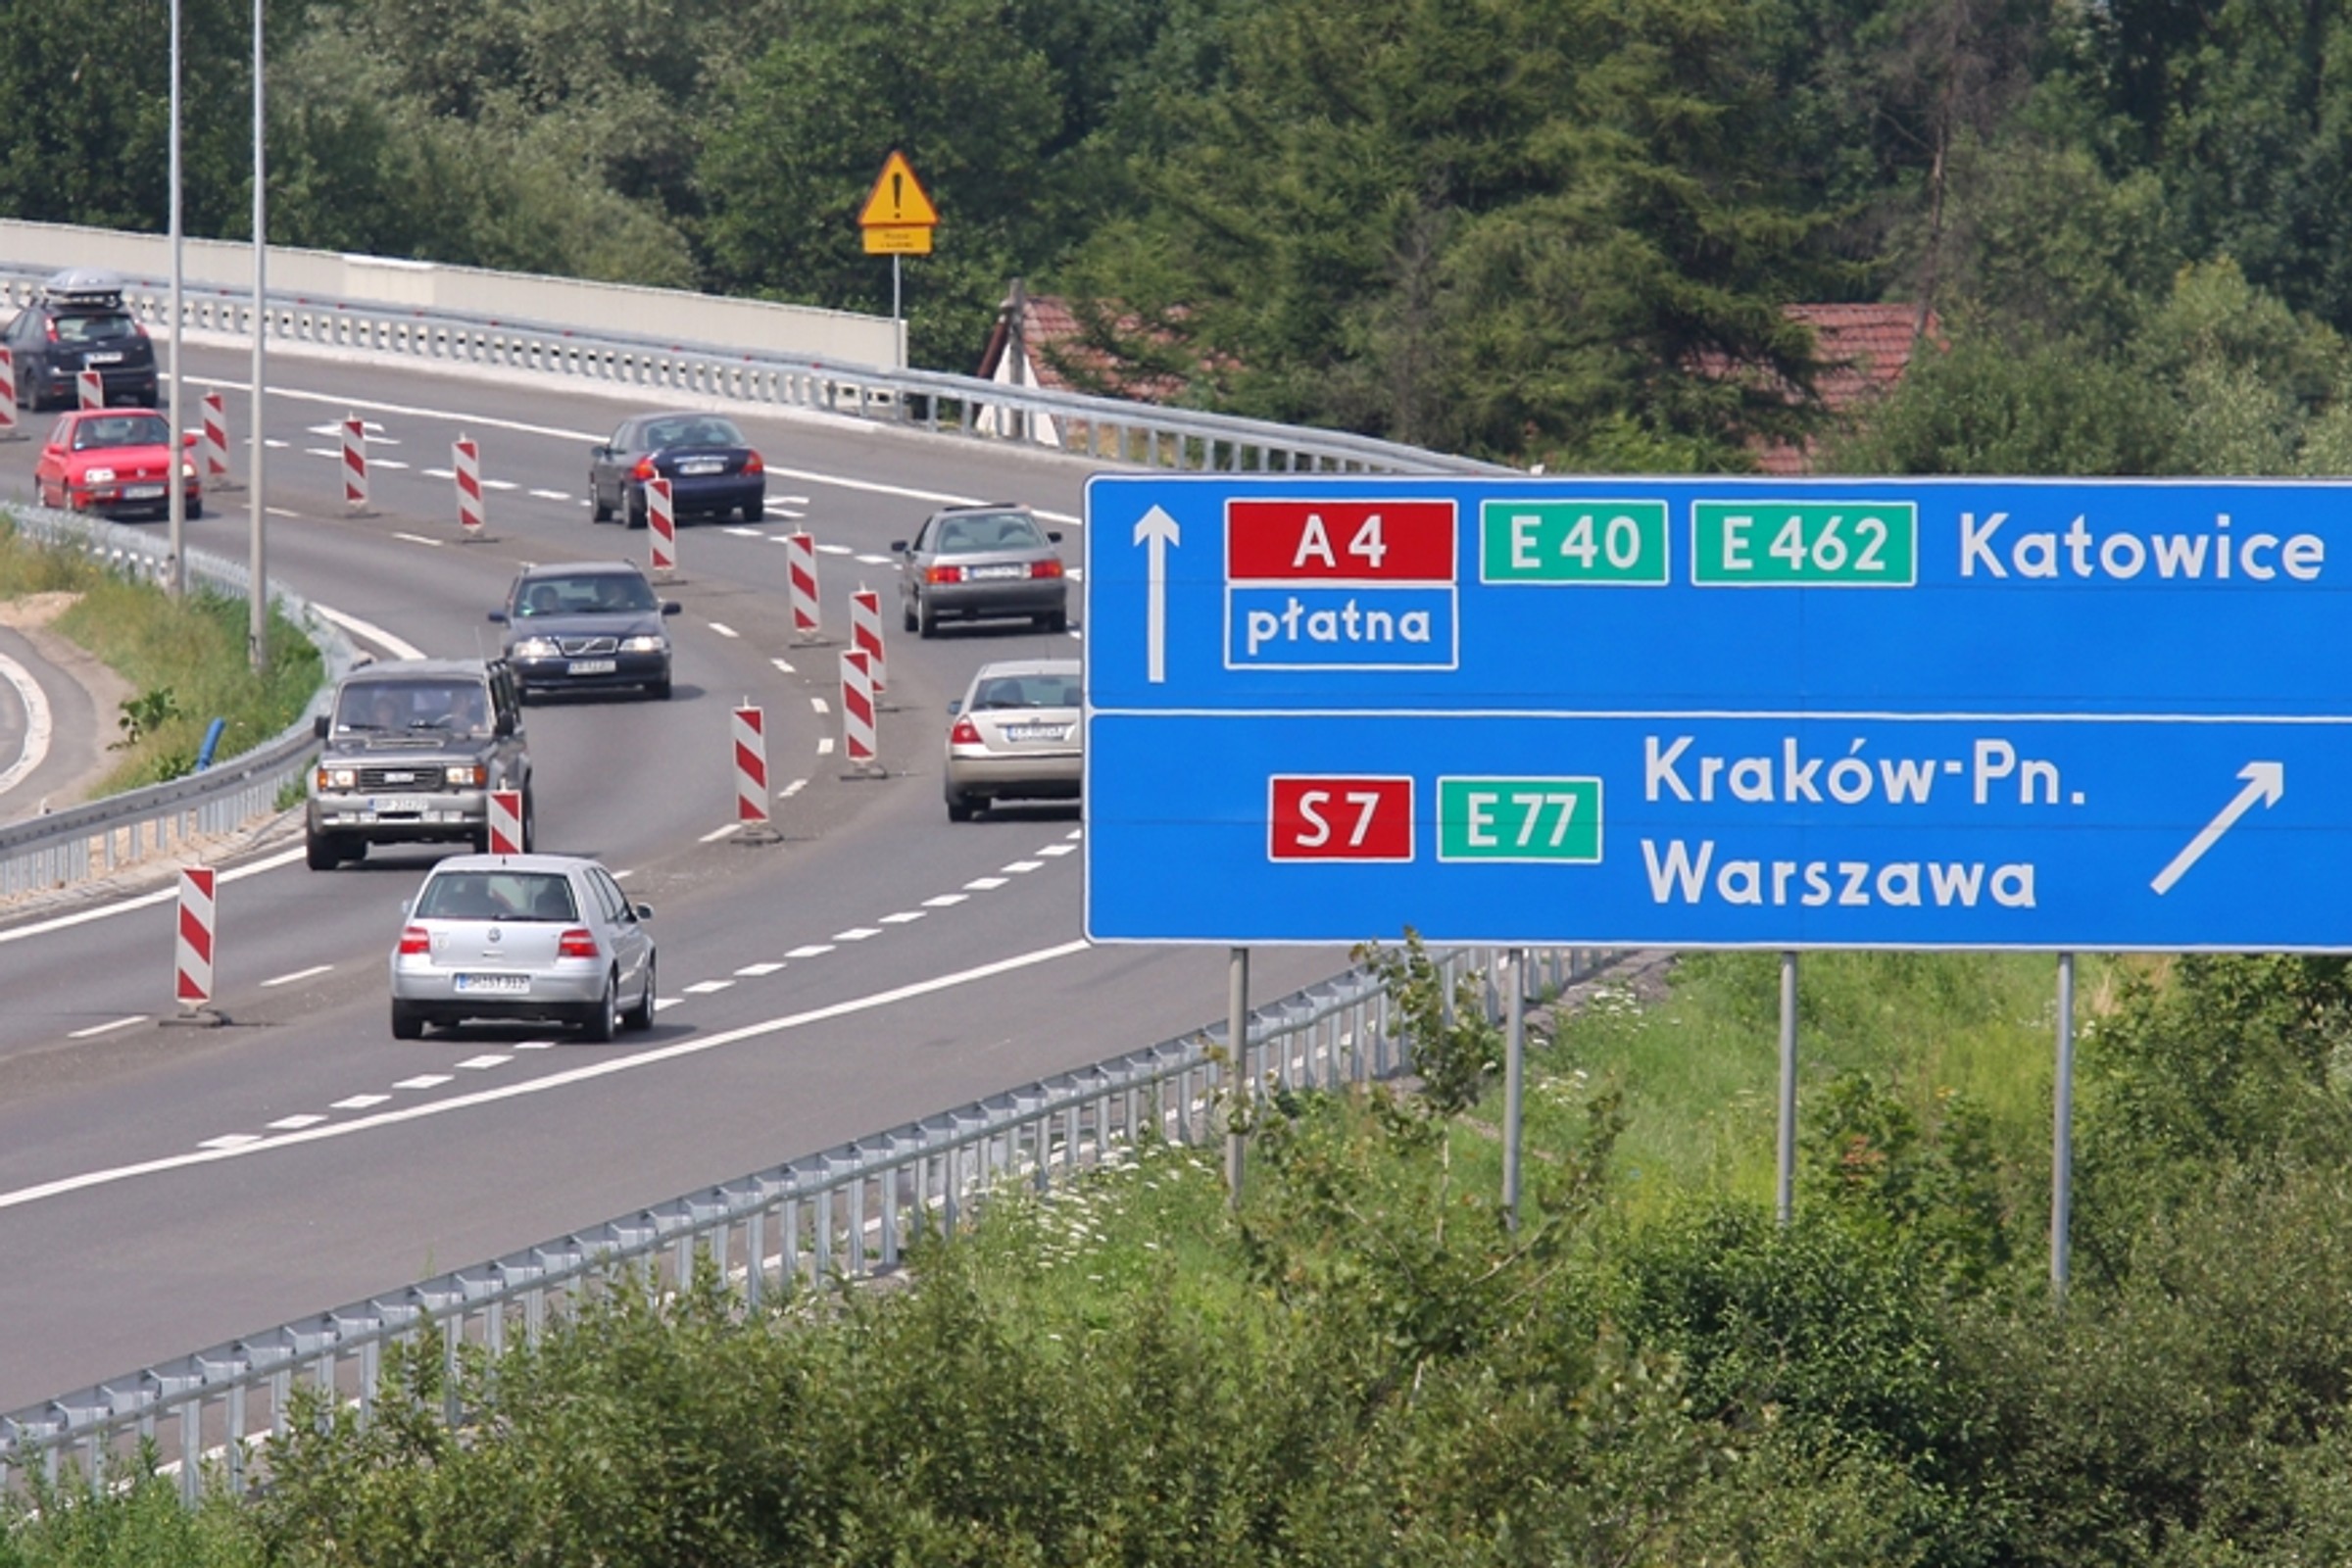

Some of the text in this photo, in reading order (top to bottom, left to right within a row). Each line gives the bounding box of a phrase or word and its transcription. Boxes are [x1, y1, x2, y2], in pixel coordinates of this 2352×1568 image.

[1961, 513, 2325, 580] Katowice
[1248, 597, 1430, 656] płatna
[1645, 736, 2085, 805] Kraków-Pn.
[1641, 839, 2036, 907] Warszawa
